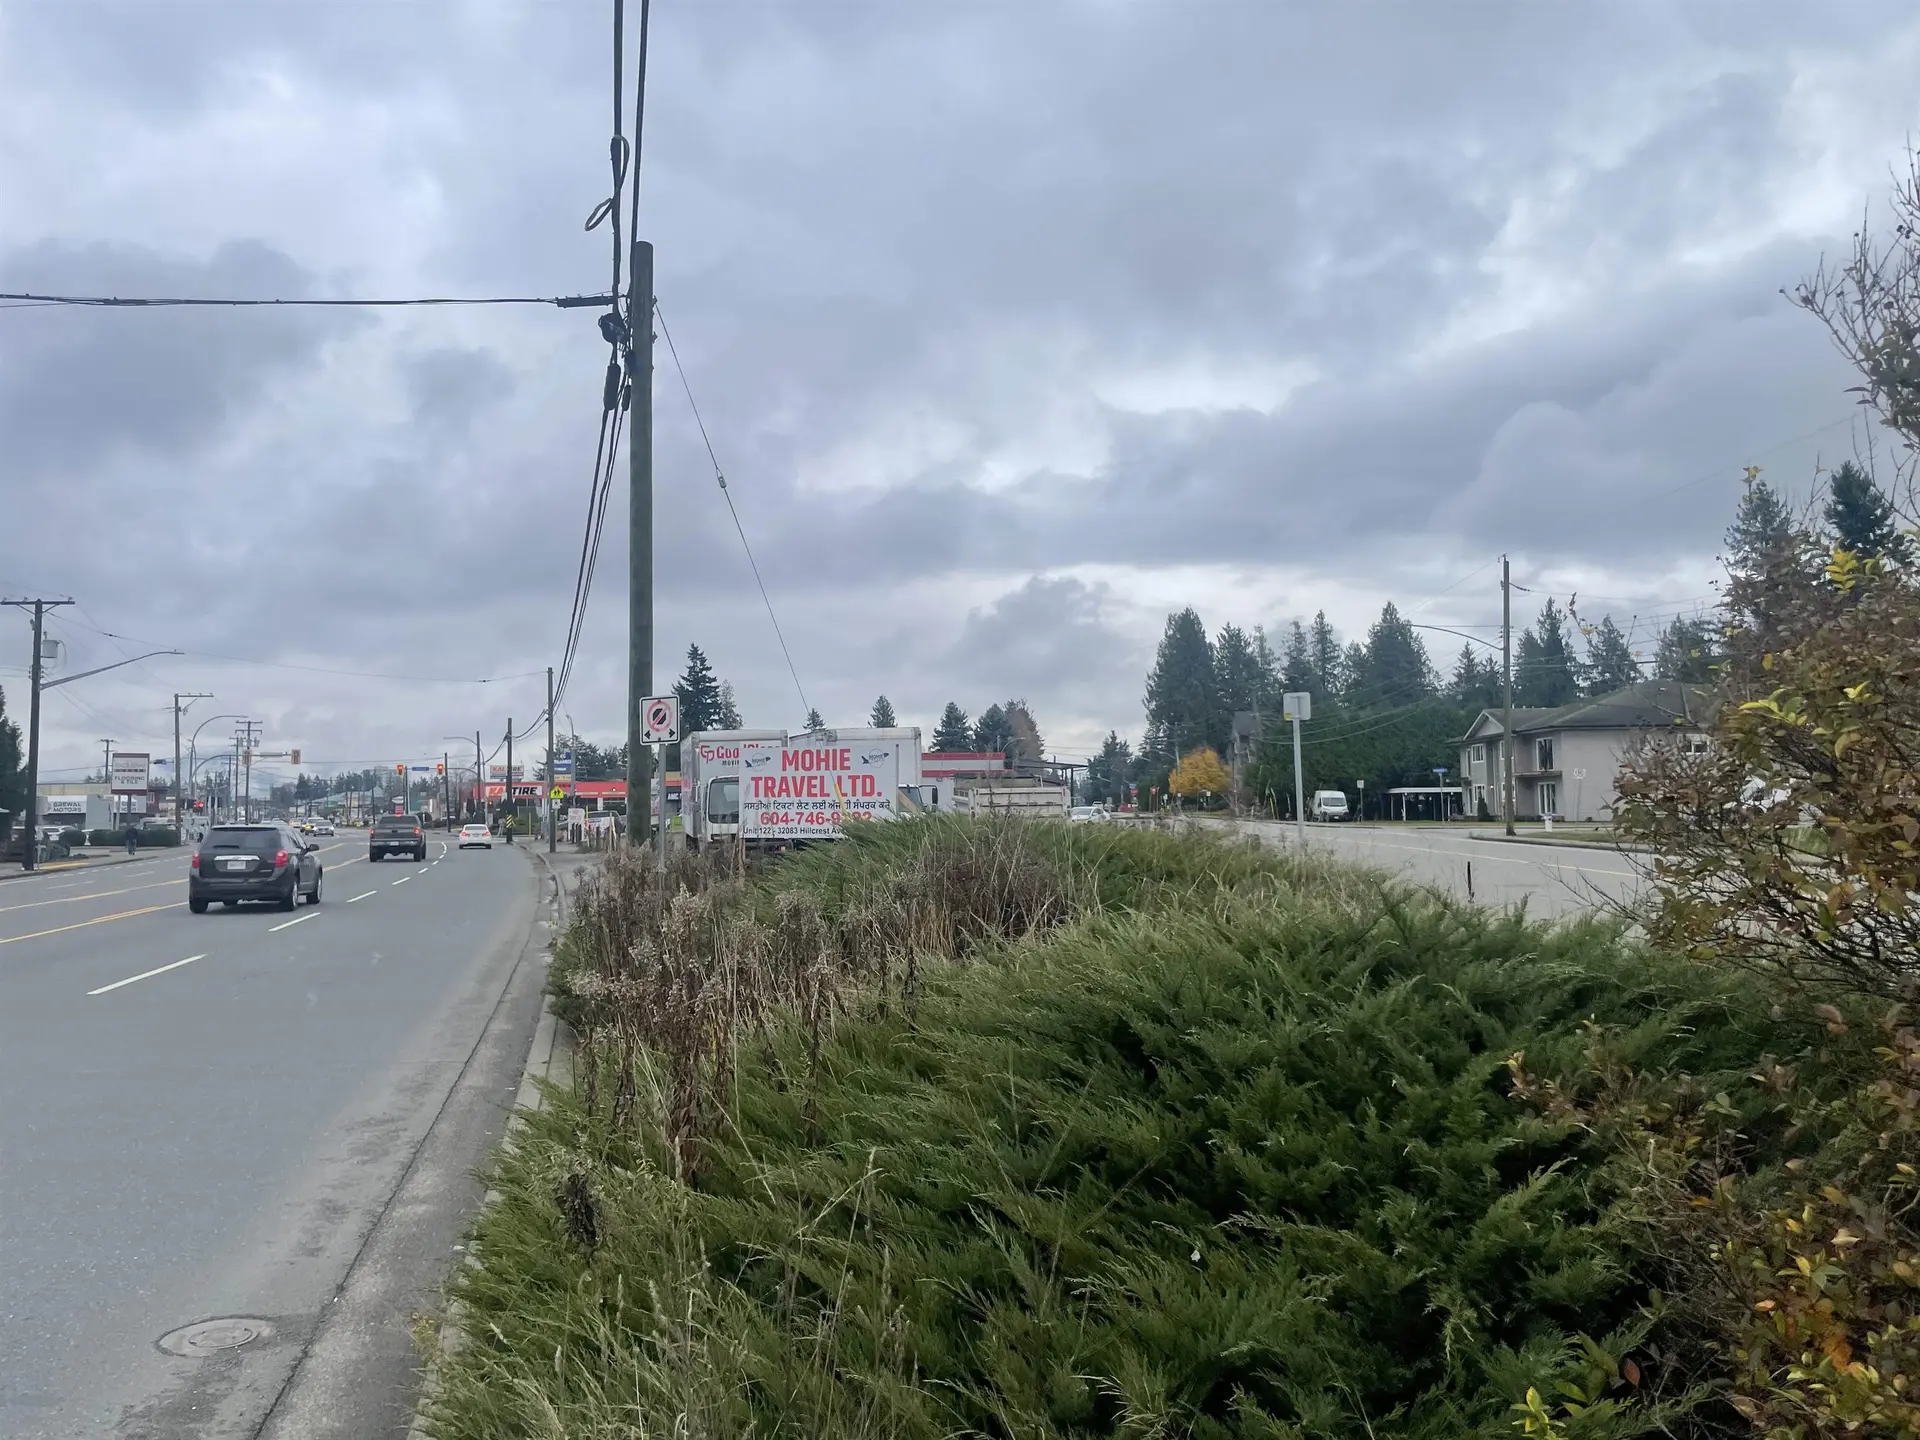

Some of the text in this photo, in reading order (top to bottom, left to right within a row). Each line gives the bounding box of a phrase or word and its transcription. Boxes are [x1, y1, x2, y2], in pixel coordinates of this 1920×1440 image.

[782, 749, 851, 771] MOHIE
[751, 775, 883, 797] TRAVEL LTD.
[743, 826, 757, 834] Unit
[800, 826, 830, 834] Hillcrest
